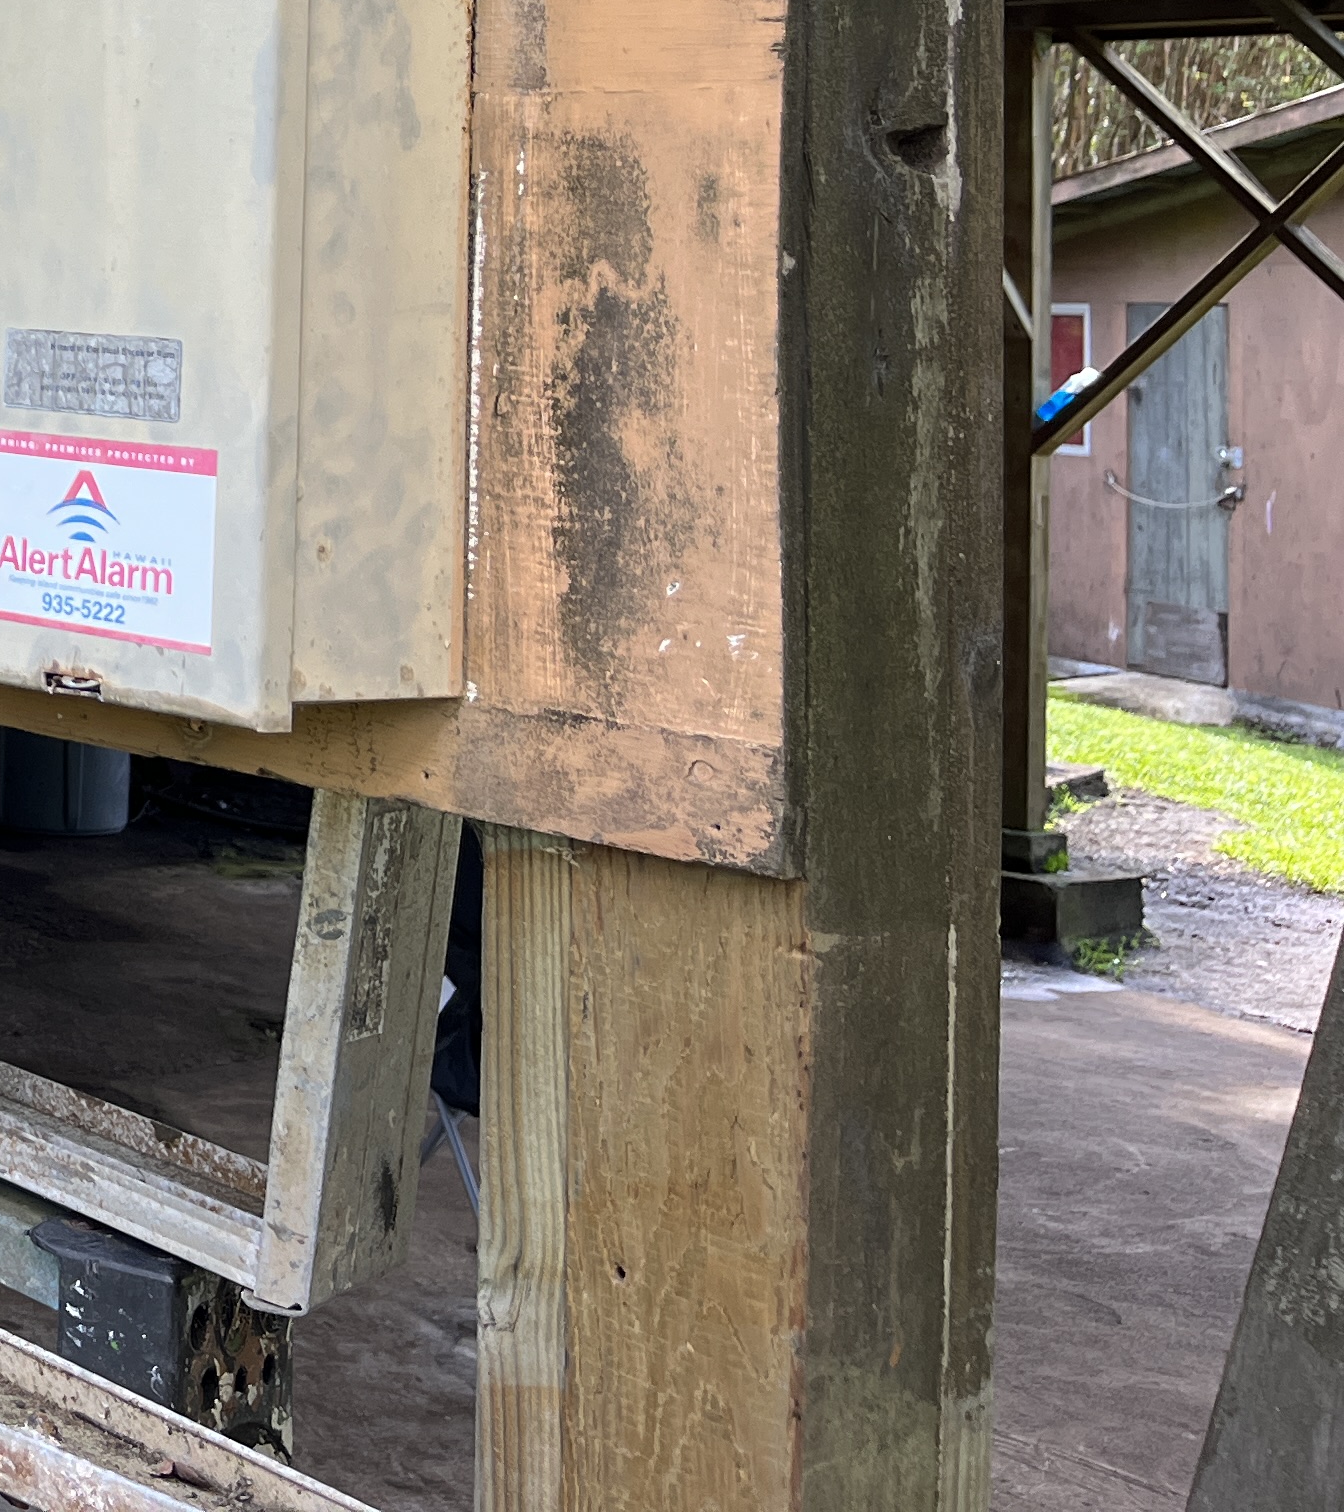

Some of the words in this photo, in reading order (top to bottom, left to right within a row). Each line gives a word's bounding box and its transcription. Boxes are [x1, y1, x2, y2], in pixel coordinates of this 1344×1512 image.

[45, 442, 102, 458] PREMISES
[107, 449, 175, 466] PROTECTED
[180, 456, 196, 468] BY
[112, 549, 173, 567] HAWAII
[41, 591, 126, 625] 935-5222
